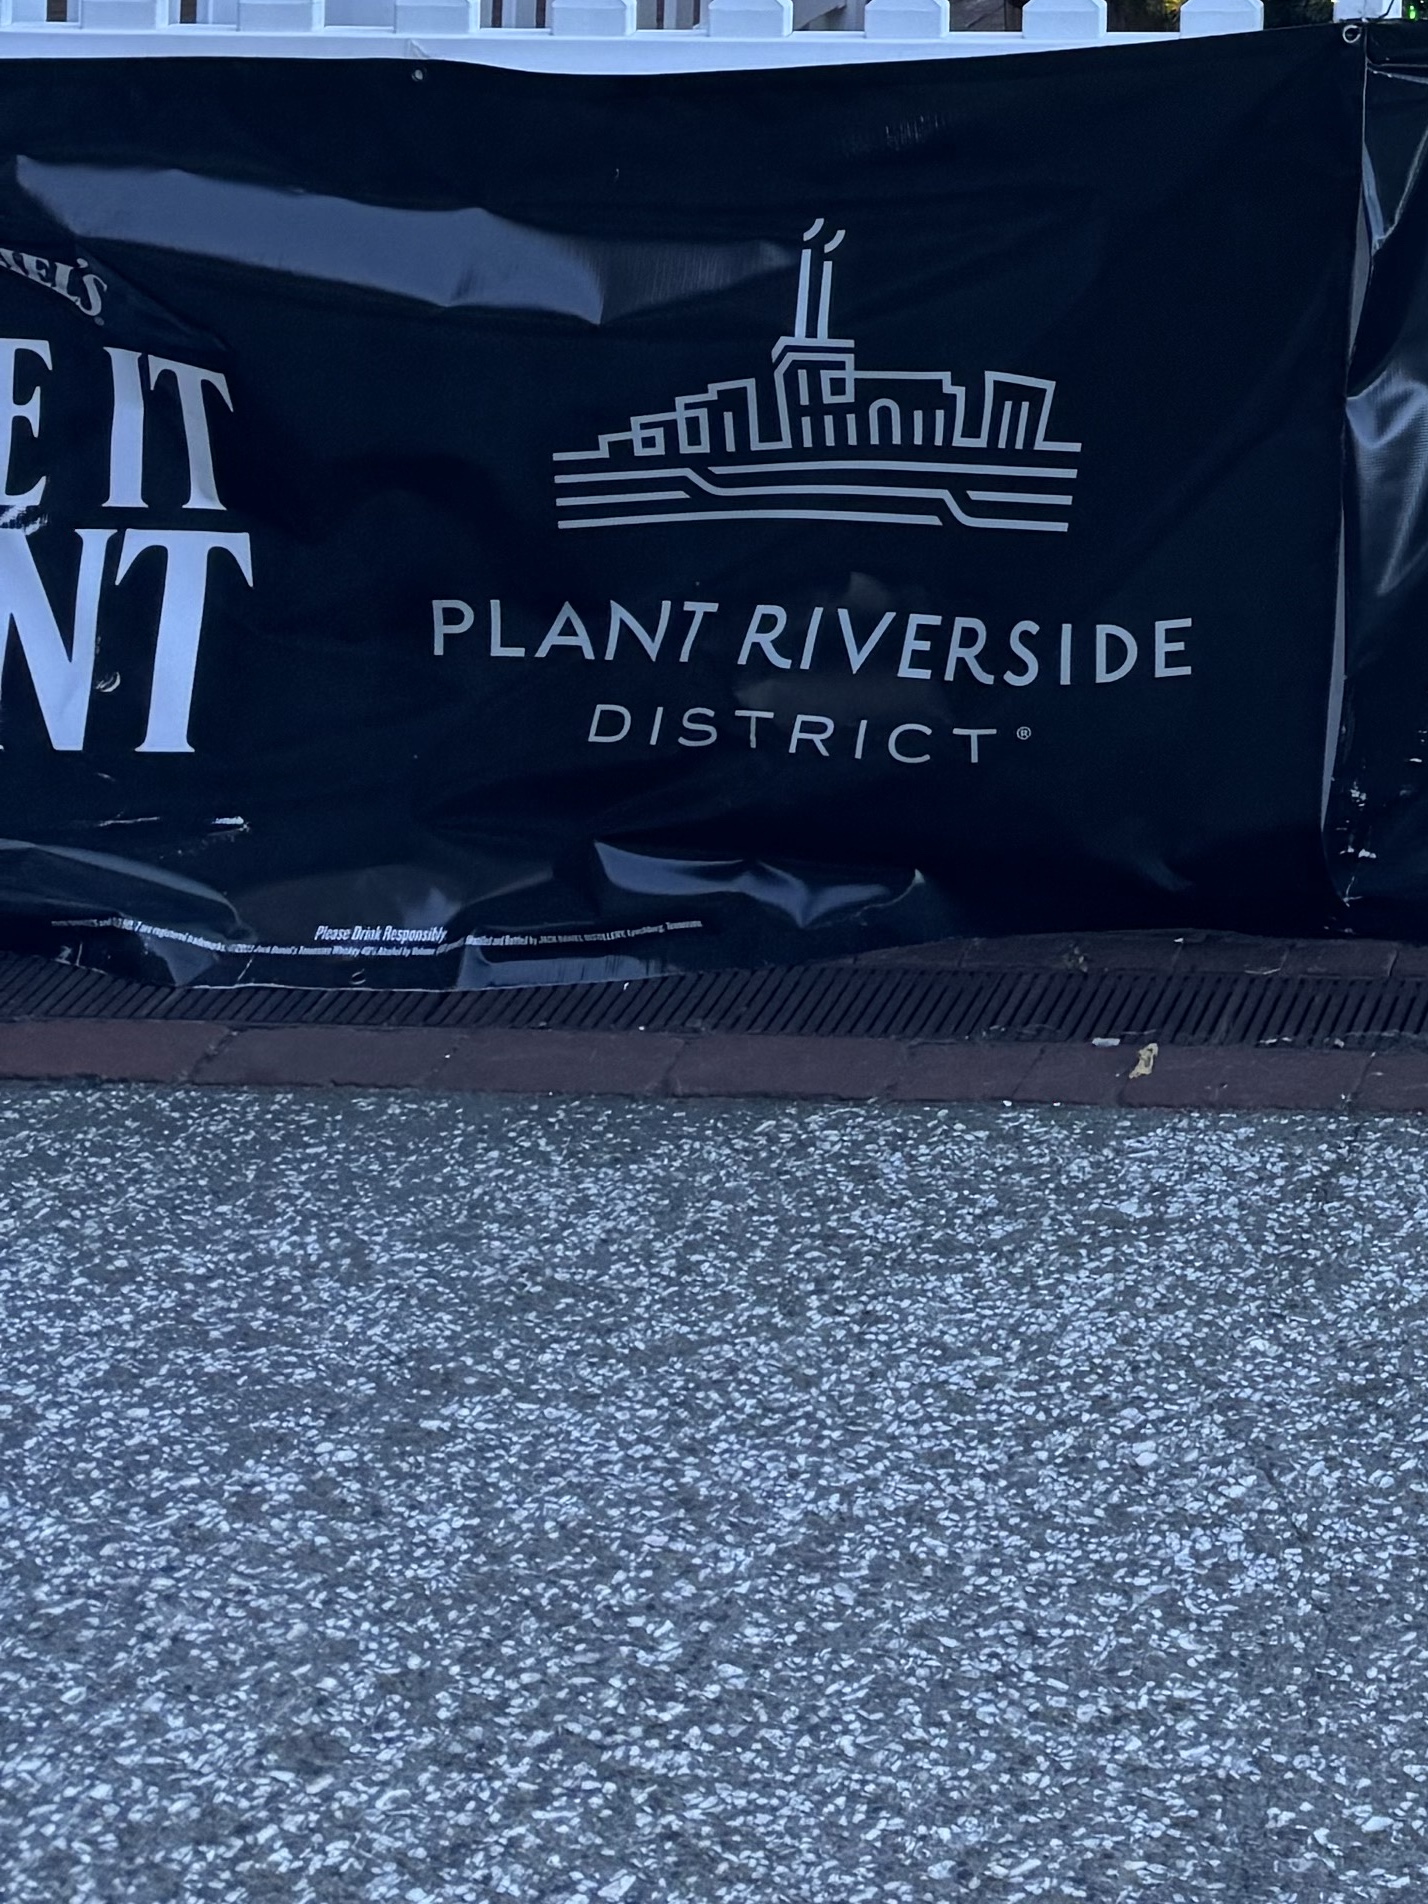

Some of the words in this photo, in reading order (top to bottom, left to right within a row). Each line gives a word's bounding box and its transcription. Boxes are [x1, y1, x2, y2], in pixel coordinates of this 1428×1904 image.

[102, 347, 234, 511] IT
[433, 598, 718, 662] PLANT
[737, 603, 1192, 687] RIVERSIDE
[314, 925, 350, 941] Please
[351, 925, 381, 941] Drink
